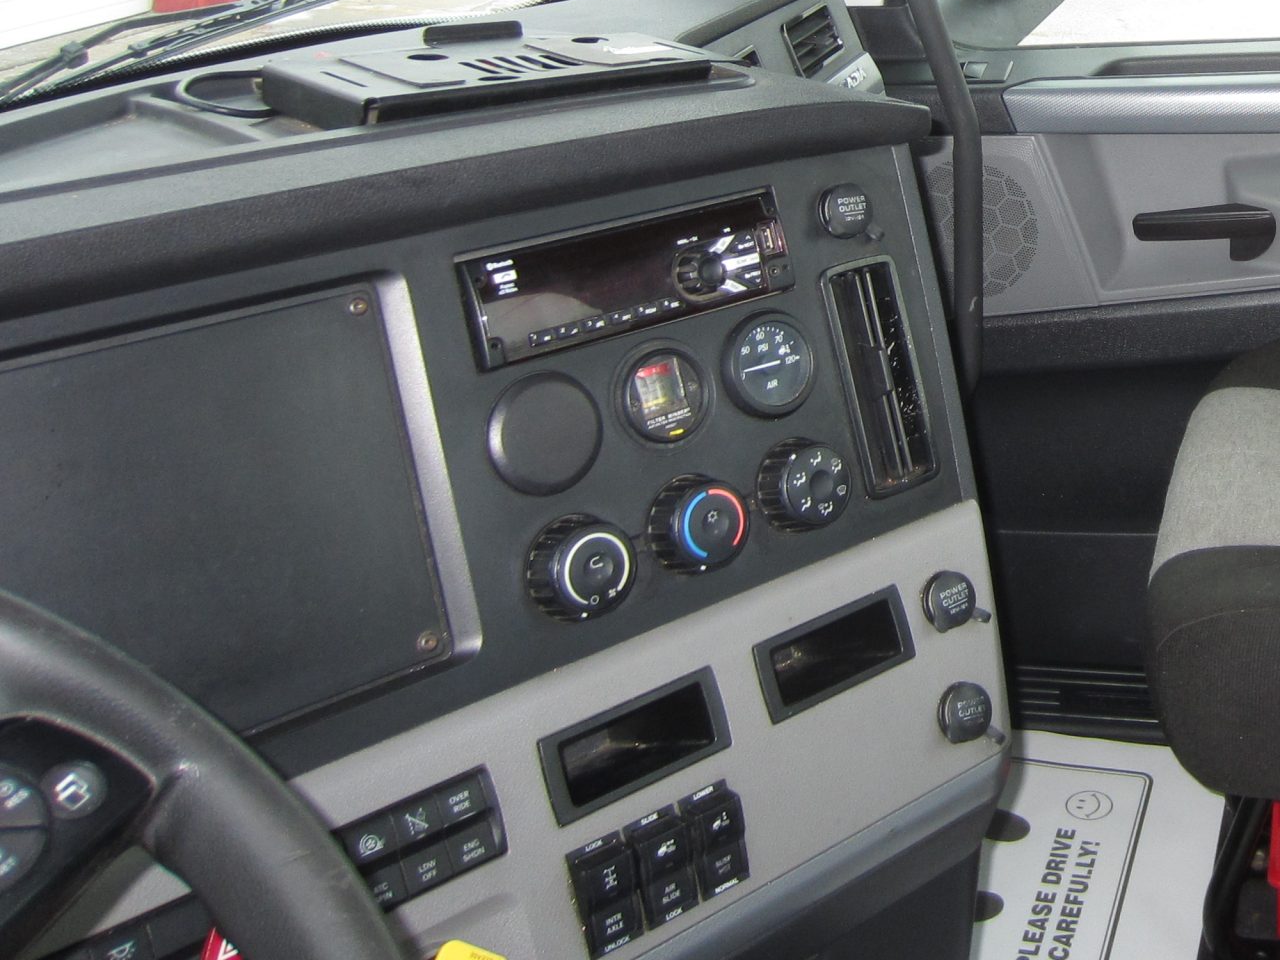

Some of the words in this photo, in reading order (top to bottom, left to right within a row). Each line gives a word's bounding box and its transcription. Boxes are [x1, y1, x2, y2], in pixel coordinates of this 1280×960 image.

[837, 195, 866, 205] POWER
[838, 202, 867, 213] OUTLET
[755, 331, 765, 341] 60
[774, 334, 784, 345] 70
[741, 345, 751, 356] 50
[757, 342, 769, 353] PSI
[785, 355, 796, 365] 120
[766, 379, 778, 390] AIR
[940, 582, 968, 600] POWER
[942, 589, 969, 607] OUTLET
[449, 790, 470, 805] OVER
[693, 785, 714, 801] LOWER
[452, 799, 472, 813] RIDE
[640, 811, 659, 826] SLIDE
[463, 838, 480, 852] ENG
[585, 839, 604, 853] LOCK
[1041, 828, 1077, 885] DRIVE
[421, 868, 438, 883] OFF
[664, 882, 677, 895] AIR
[714, 878, 740, 895] NORMAL
[662, 890, 681, 904] SLIDE
[1047, 840, 1101, 960] CAREFULLY!
[665, 907, 683, 921] LOCK
[606, 921, 624, 935] AXLE
[604, 935, 631, 953] UNLOCK
